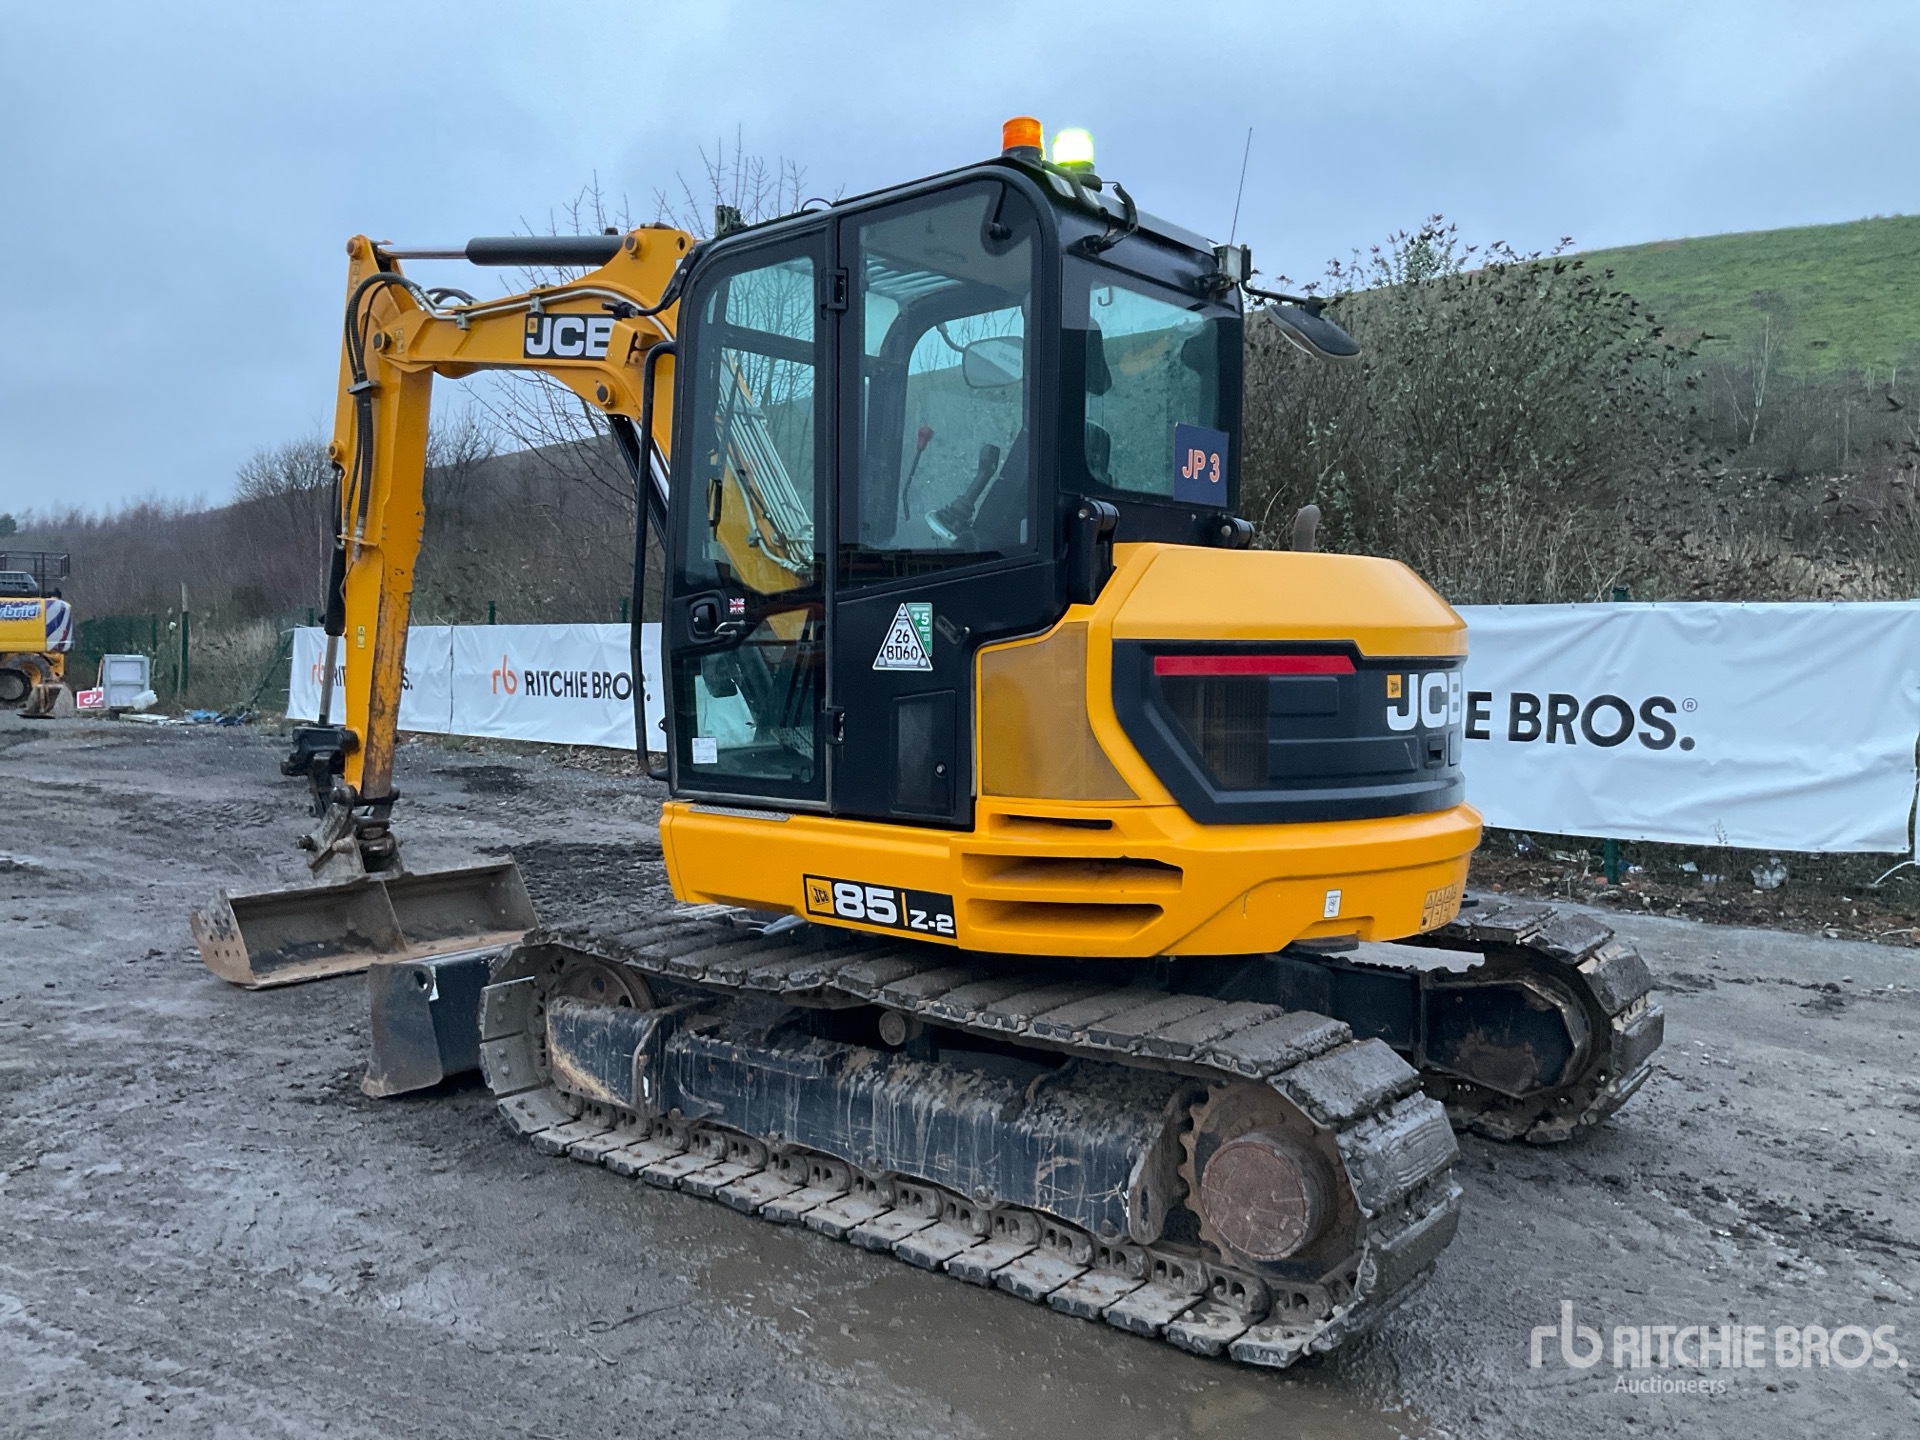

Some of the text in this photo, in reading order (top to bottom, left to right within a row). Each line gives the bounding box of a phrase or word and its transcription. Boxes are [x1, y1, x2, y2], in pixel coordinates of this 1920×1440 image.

[1182, 449, 1220, 483] JP 3
[921, 612, 929, 625] 5
[886, 646, 918, 661] BD60
[895, 629, 910, 644] 26
[492, 655, 518, 695] rb
[524, 670, 588, 698] RITCHIE
[1386, 671, 1461, 731] JCB
[834, 883, 955, 934] 85 Z-2
